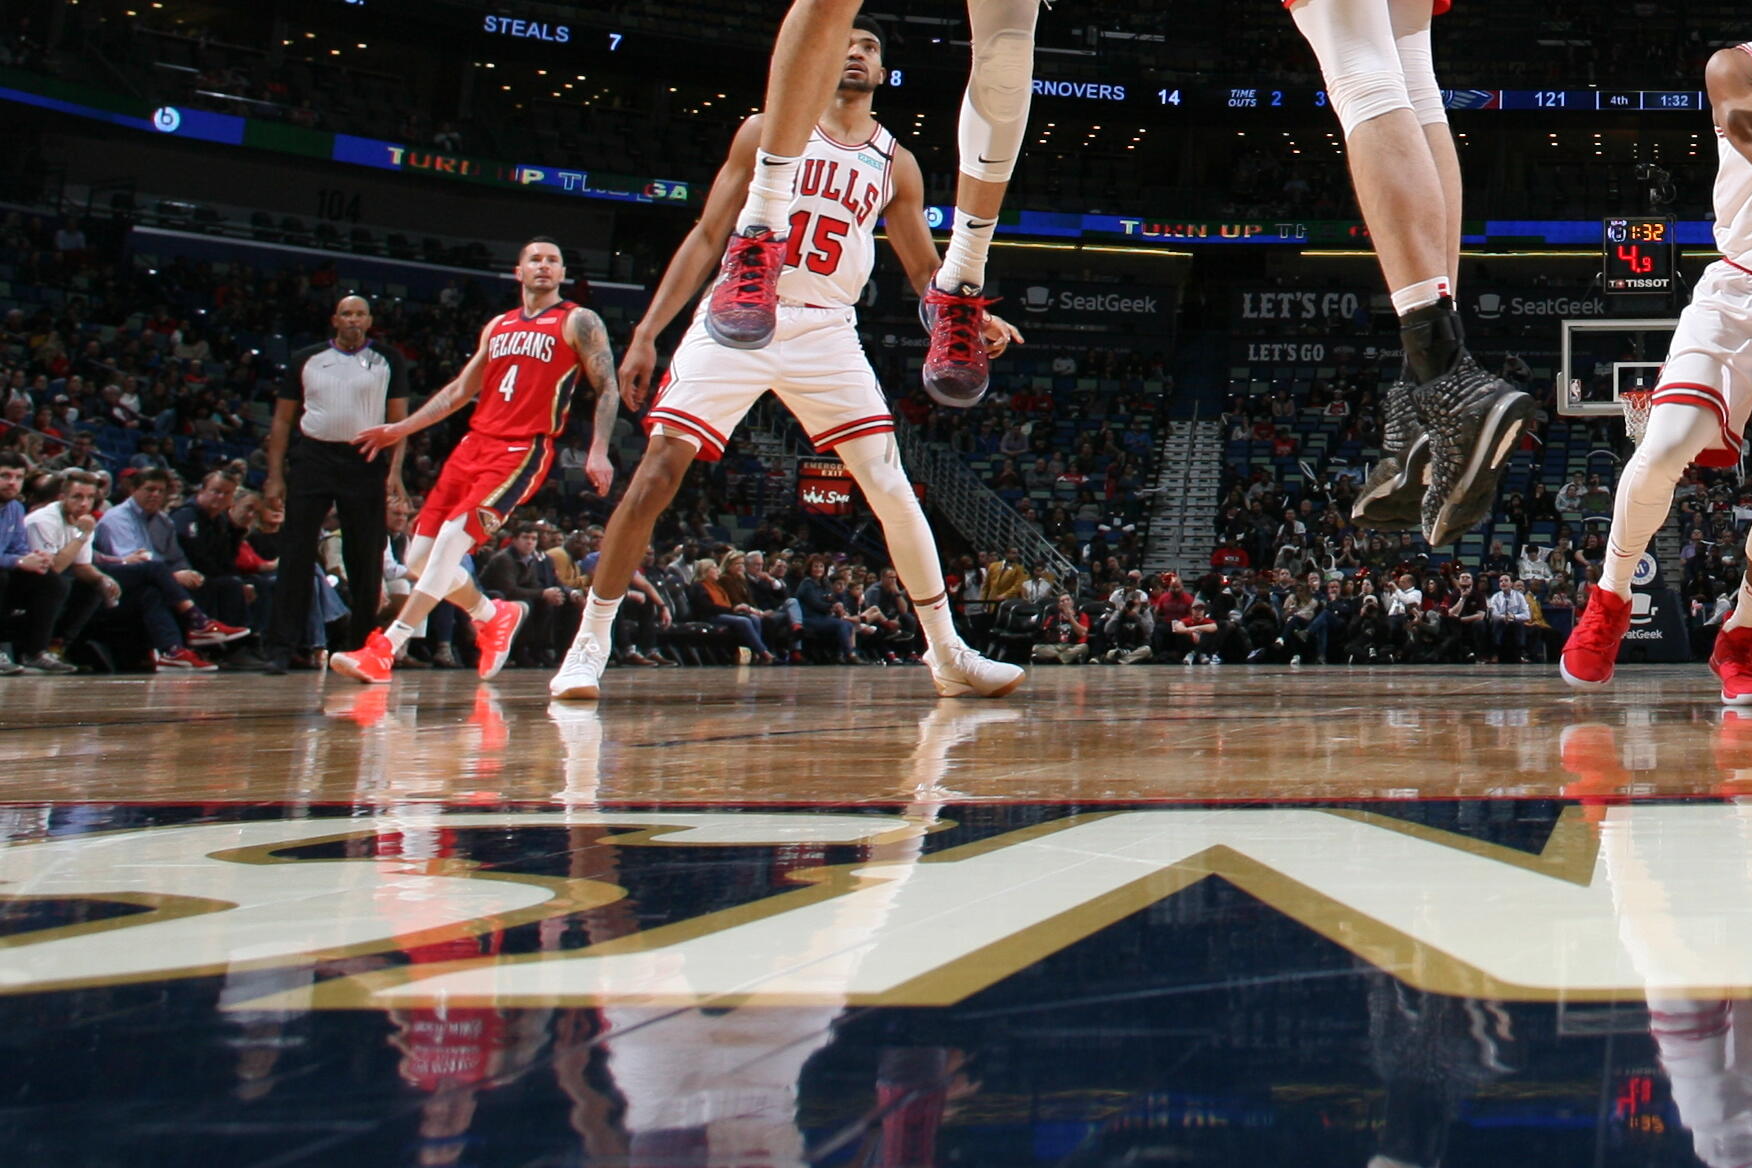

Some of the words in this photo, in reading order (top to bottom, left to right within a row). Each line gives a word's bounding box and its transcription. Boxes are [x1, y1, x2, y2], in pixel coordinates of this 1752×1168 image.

[483, 14, 570, 44] STEALS
[608, 33, 623, 52] 7
[889, 69, 902, 87] 8
[1030, 80, 1125, 100] RNOVERS
[1157, 89, 1180, 106] 14
[1229, 89, 1257, 99] TIME
[1270, 90, 1282, 106] 2
[1533, 91, 1567, 108] 121
[1609, 94, 1629, 106] 4th
[1659, 94, 1689, 107] 1:32
[1228, 98, 1258, 108] OUTS
[792, 157, 880, 227] ULLS
[1220, 223, 1263, 238] UP
[1631, 222, 1665, 242] 1:32
[783, 209, 851, 277] 15
[1626, 278, 1670, 288] TISSOT
[1059, 292, 1157, 313] SeatGeek
[1242, 292, 1316, 319] LET'S
[1511, 298, 1605, 316] SeatGeek
[488, 330, 556, 364] PELICANS
[1248, 343, 1297, 361] LET'S
[1300, 343, 1325, 361] GO
[498, 364, 520, 403] 4
[820, 469, 844, 478] EXIT
